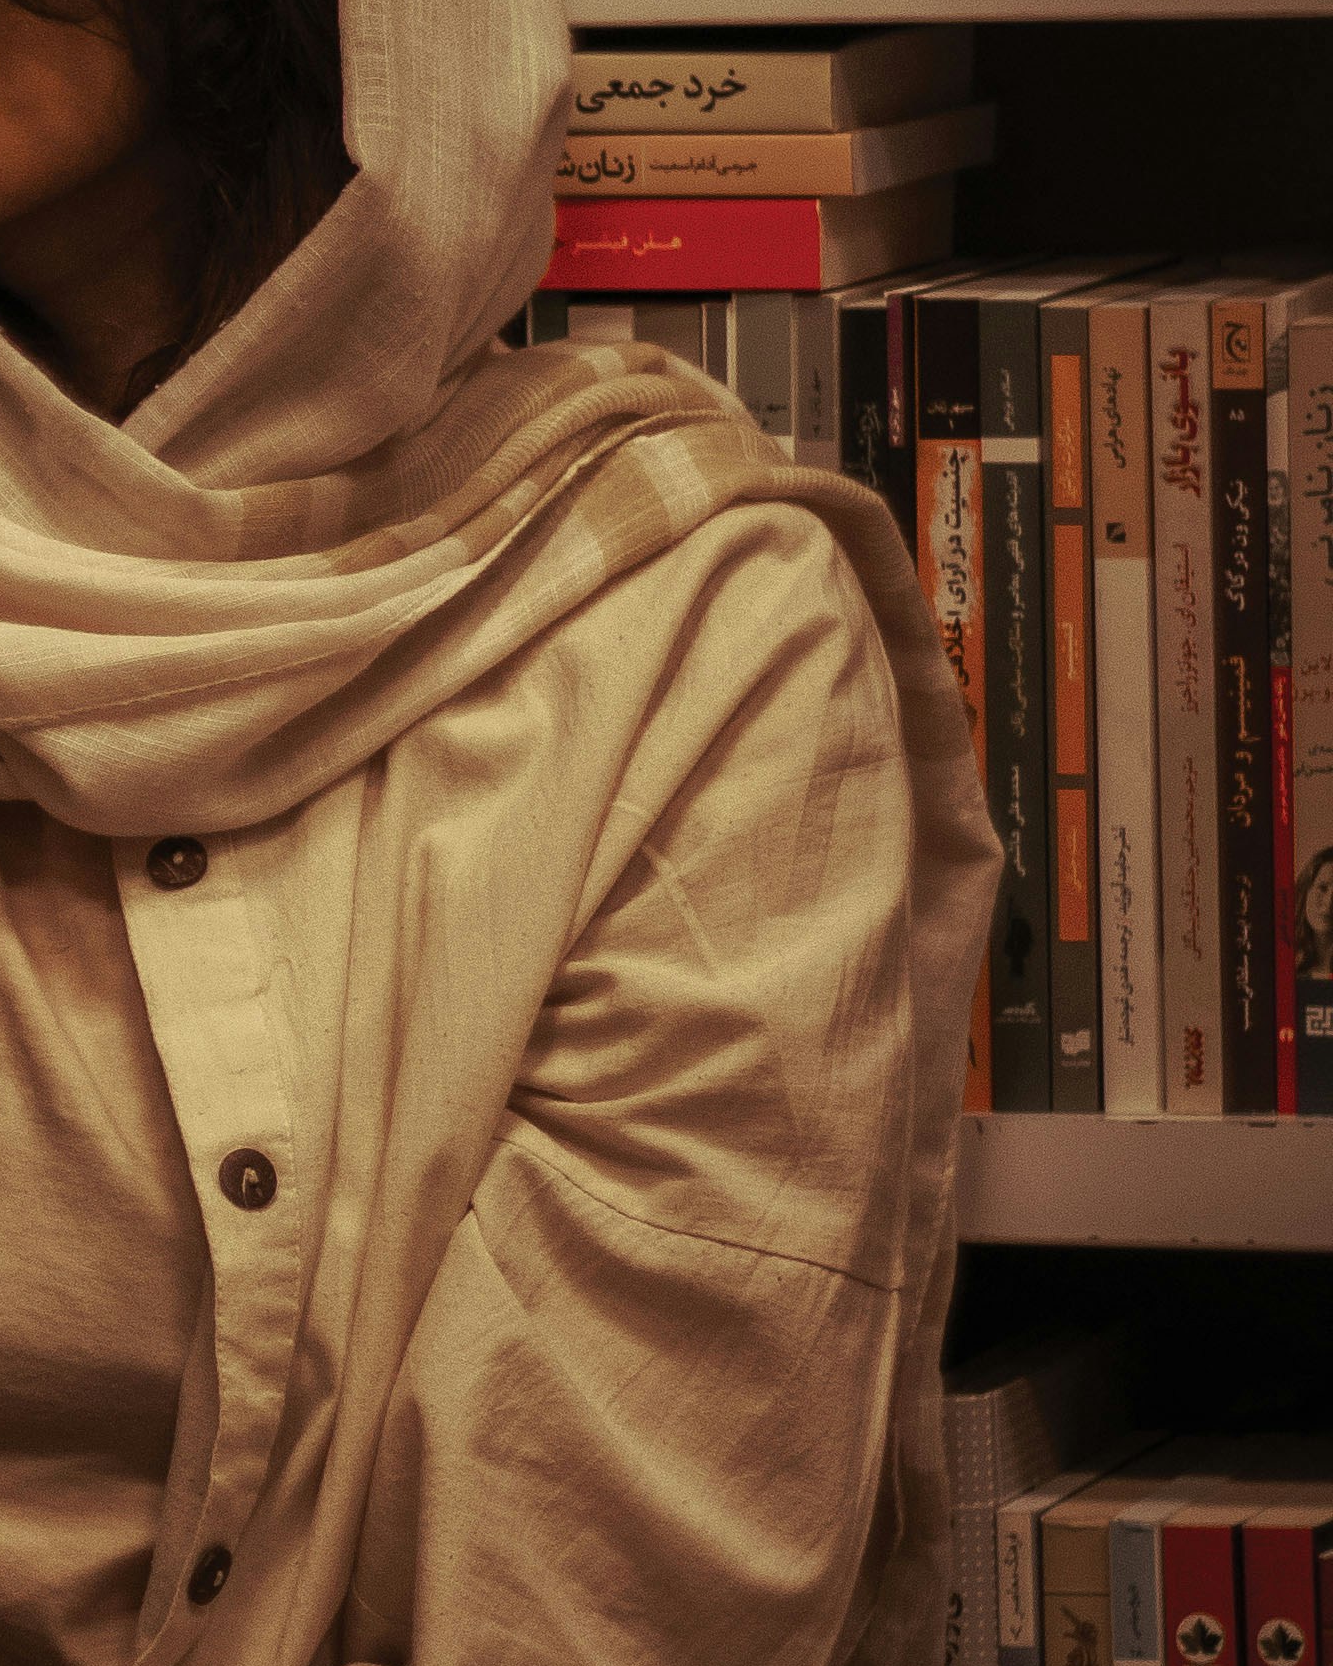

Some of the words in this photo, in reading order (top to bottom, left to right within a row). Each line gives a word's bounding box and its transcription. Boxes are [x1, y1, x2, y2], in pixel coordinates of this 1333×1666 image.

[575, 75, 676, 114] جمعی
[683, 69, 748, 113] خرد
[573, 149, 637, 184] زنان
[1159, 347, 1198, 439] بانوی
[942, 447, 962, 529] جنسیت
[1164, 442, 1202, 497] بازار
[1220, 653, 1263, 741] فمینیسم
[1227, 771, 1255, 828] مردان
